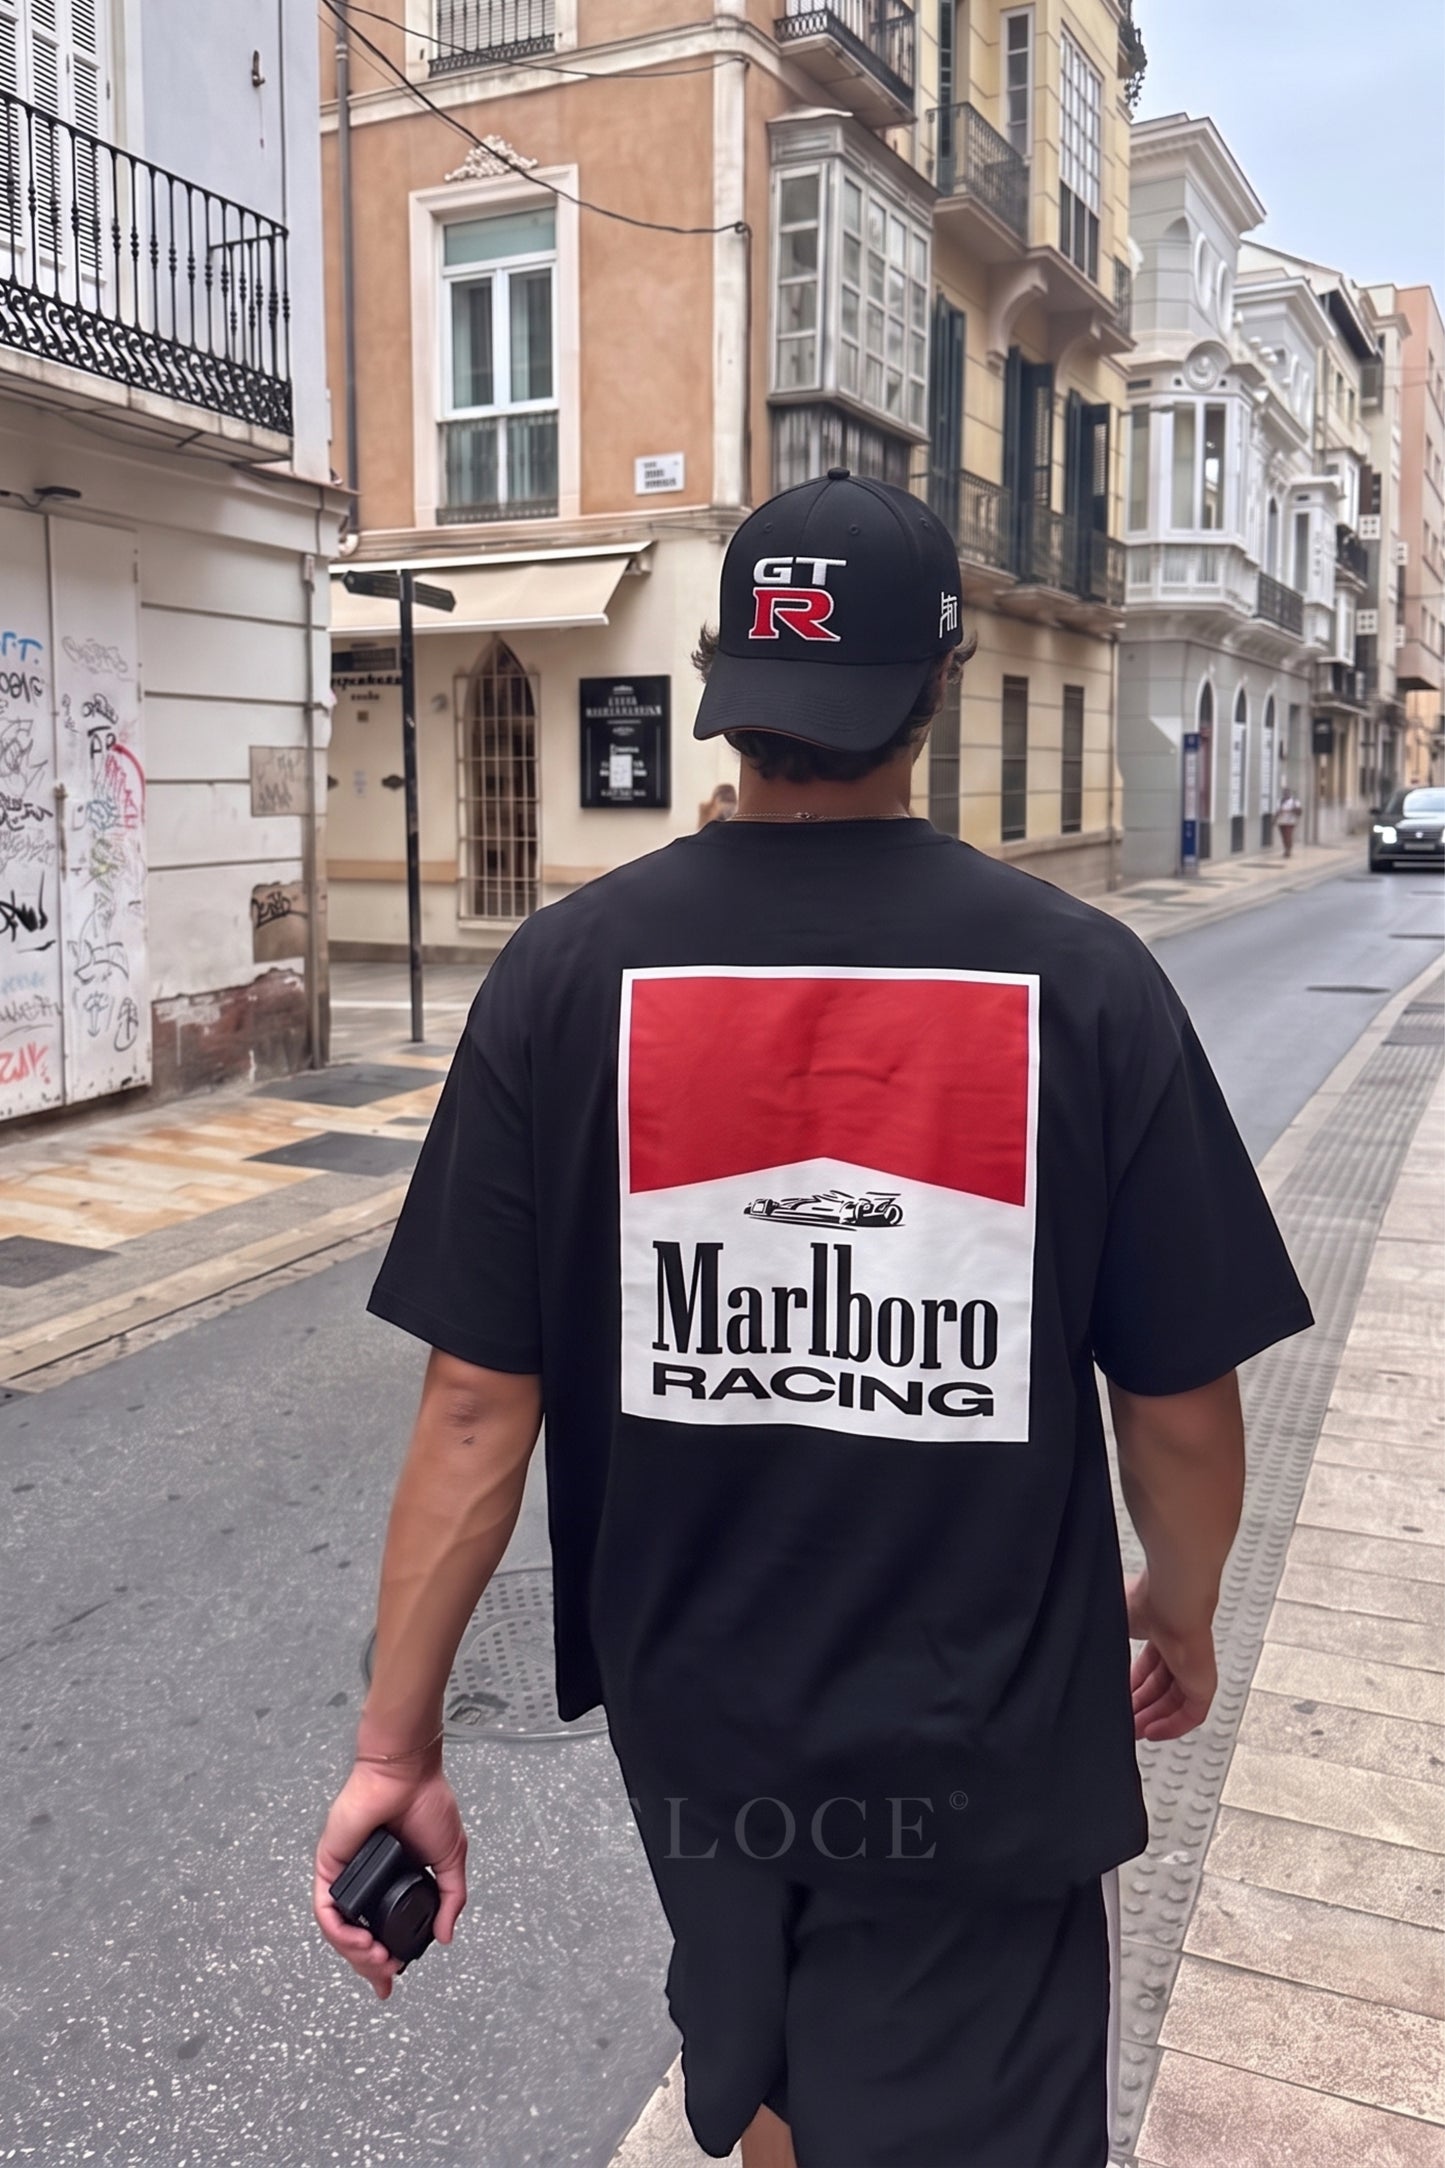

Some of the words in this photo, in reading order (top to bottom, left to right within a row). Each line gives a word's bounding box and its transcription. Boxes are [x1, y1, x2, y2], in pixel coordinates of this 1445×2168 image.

[753, 557, 847, 586] GT
[748, 587, 842, 642] R
[653, 1241, 998, 1369] Marlboro
[653, 1362, 995, 1417] RACING
